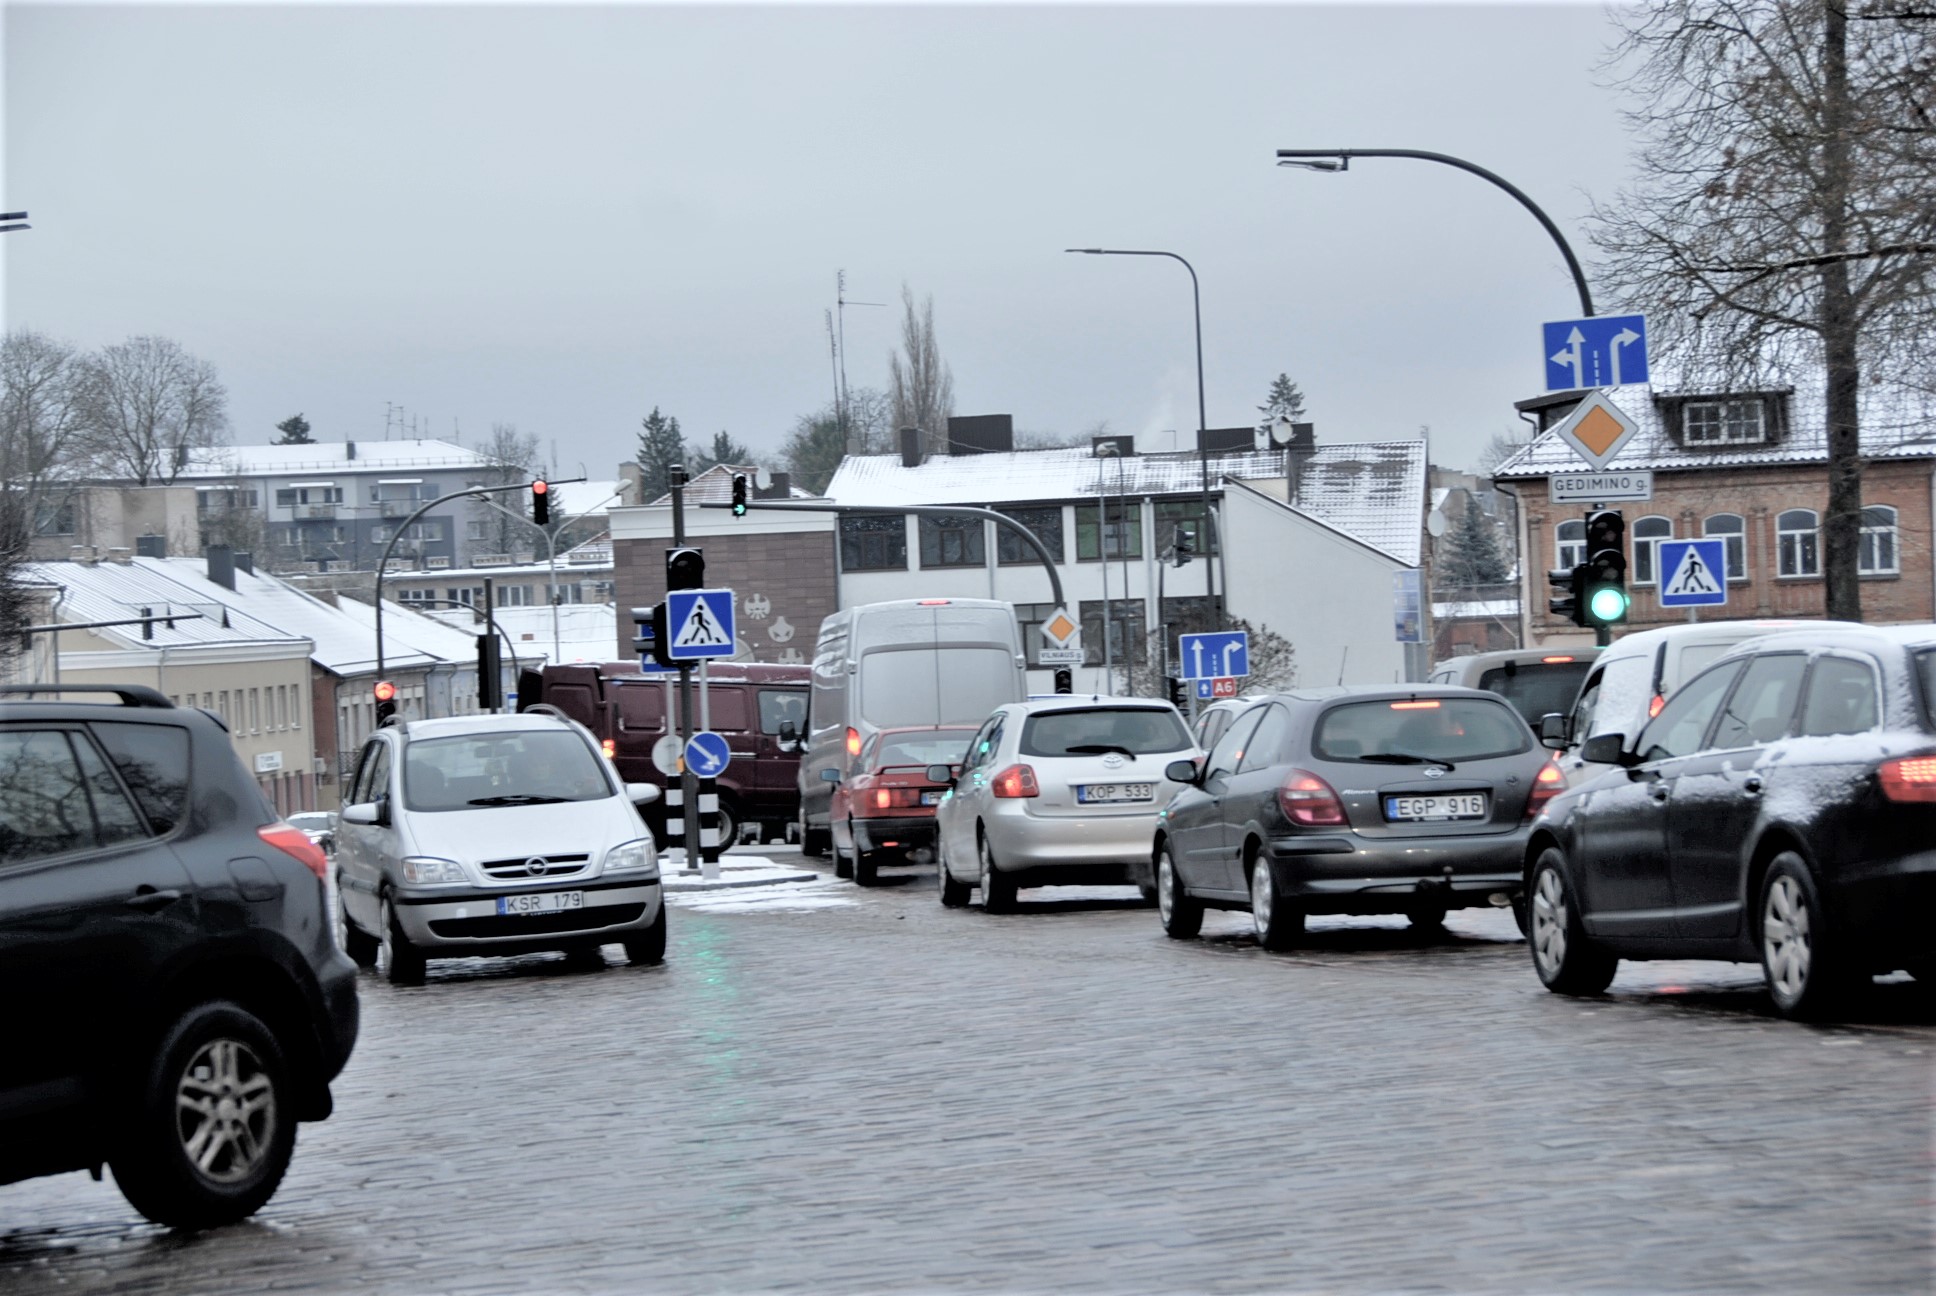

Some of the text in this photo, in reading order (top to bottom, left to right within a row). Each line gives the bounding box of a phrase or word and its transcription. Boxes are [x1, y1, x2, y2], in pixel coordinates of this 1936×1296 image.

[1555, 478, 1630, 491] GEDIMINO
[1215, 681, 1233, 694] A6
[1086, 784, 1150, 799] KOP 533
[1399, 797, 1481, 815] EGP 916
[506, 892, 580, 912] KSR 179
